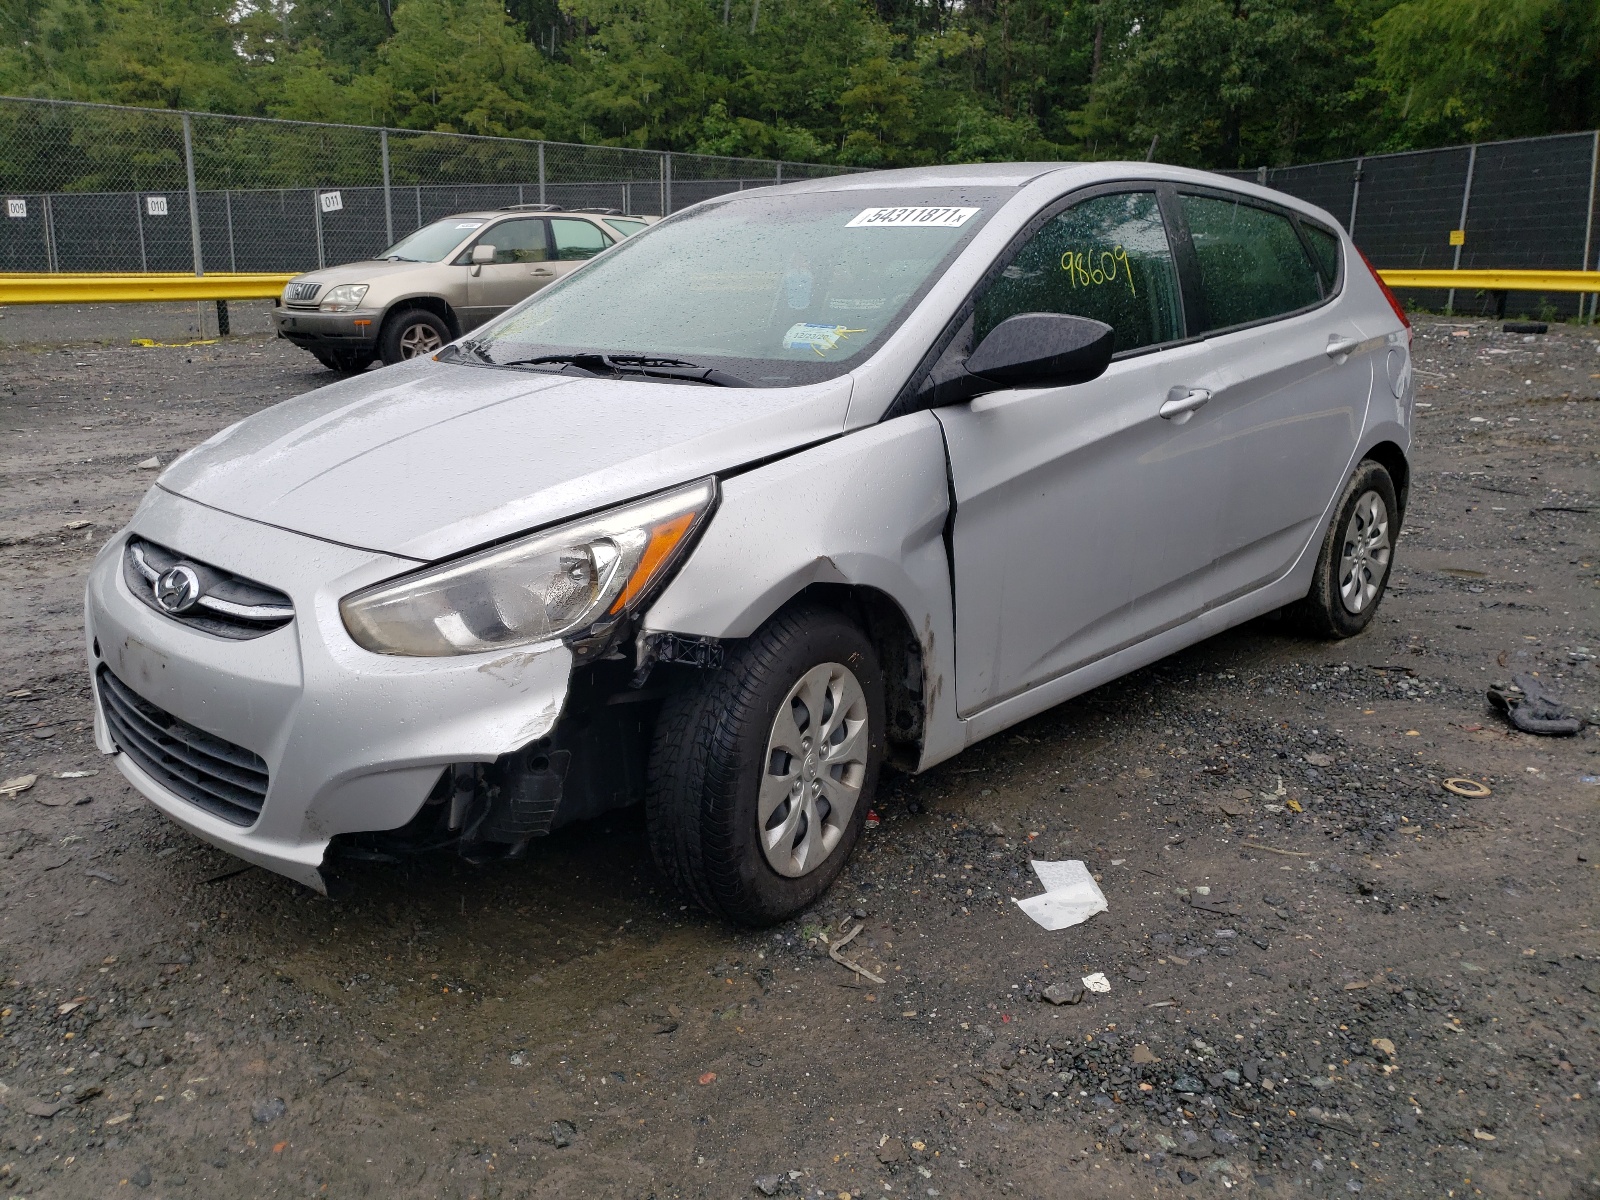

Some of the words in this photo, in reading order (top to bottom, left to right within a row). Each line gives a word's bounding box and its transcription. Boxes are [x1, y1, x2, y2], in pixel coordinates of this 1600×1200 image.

[151, 200, 165, 212] 010
[325, 195, 338, 208] 011
[11, 203, 25, 214] 009
[1061, 245, 1136, 299] 98609
